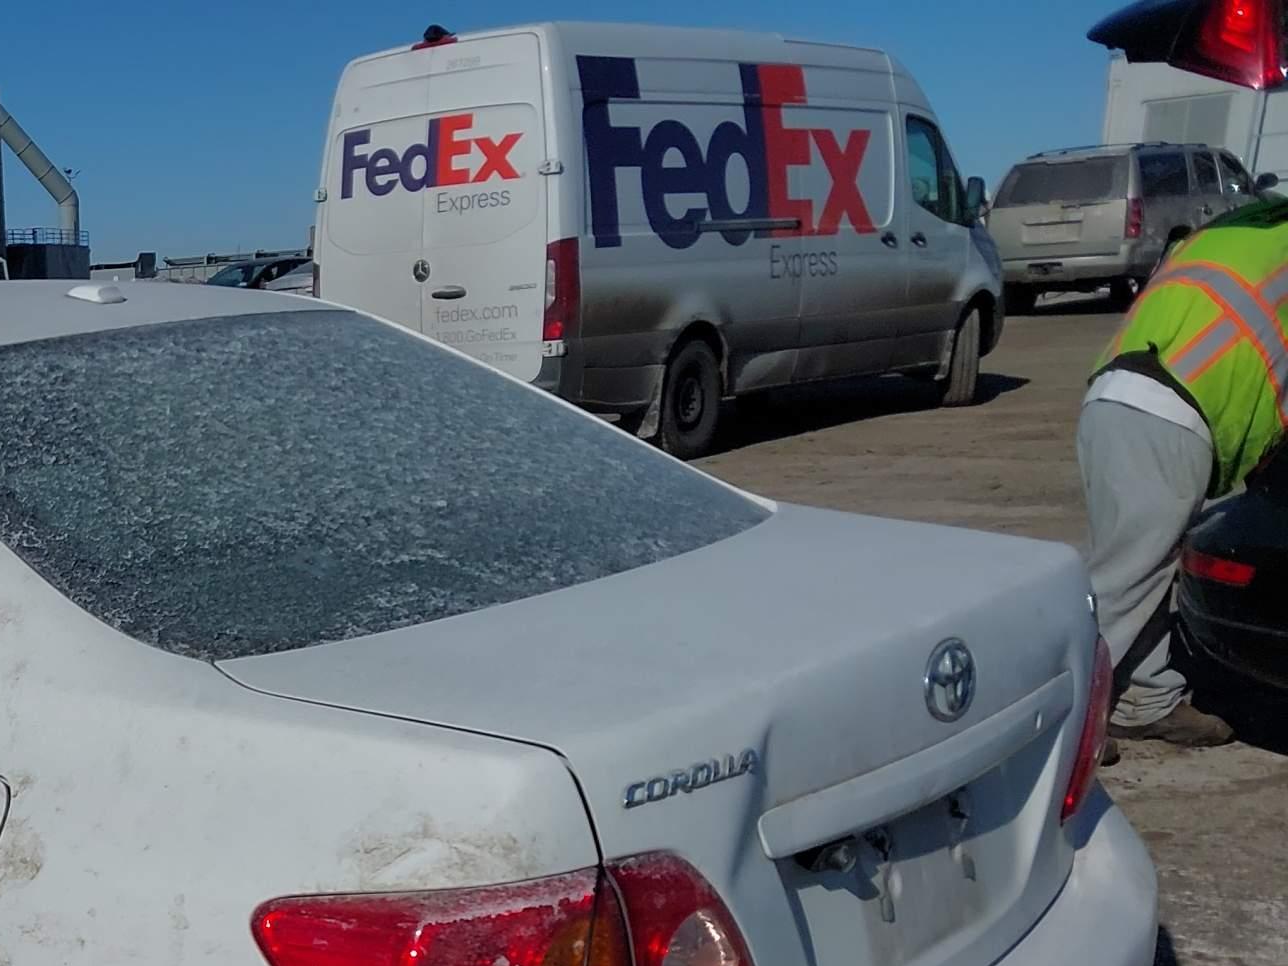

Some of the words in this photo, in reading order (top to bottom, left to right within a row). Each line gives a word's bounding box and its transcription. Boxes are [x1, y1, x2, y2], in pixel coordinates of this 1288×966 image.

[341, 113, 524, 200] FedEx
[575, 55, 879, 249] FedEx
[437, 189, 512, 216] Express
[770, 245, 838, 286] Express
[433, 304, 518, 324] fedex.com
[623, 748, 761, 808] COROLLA
